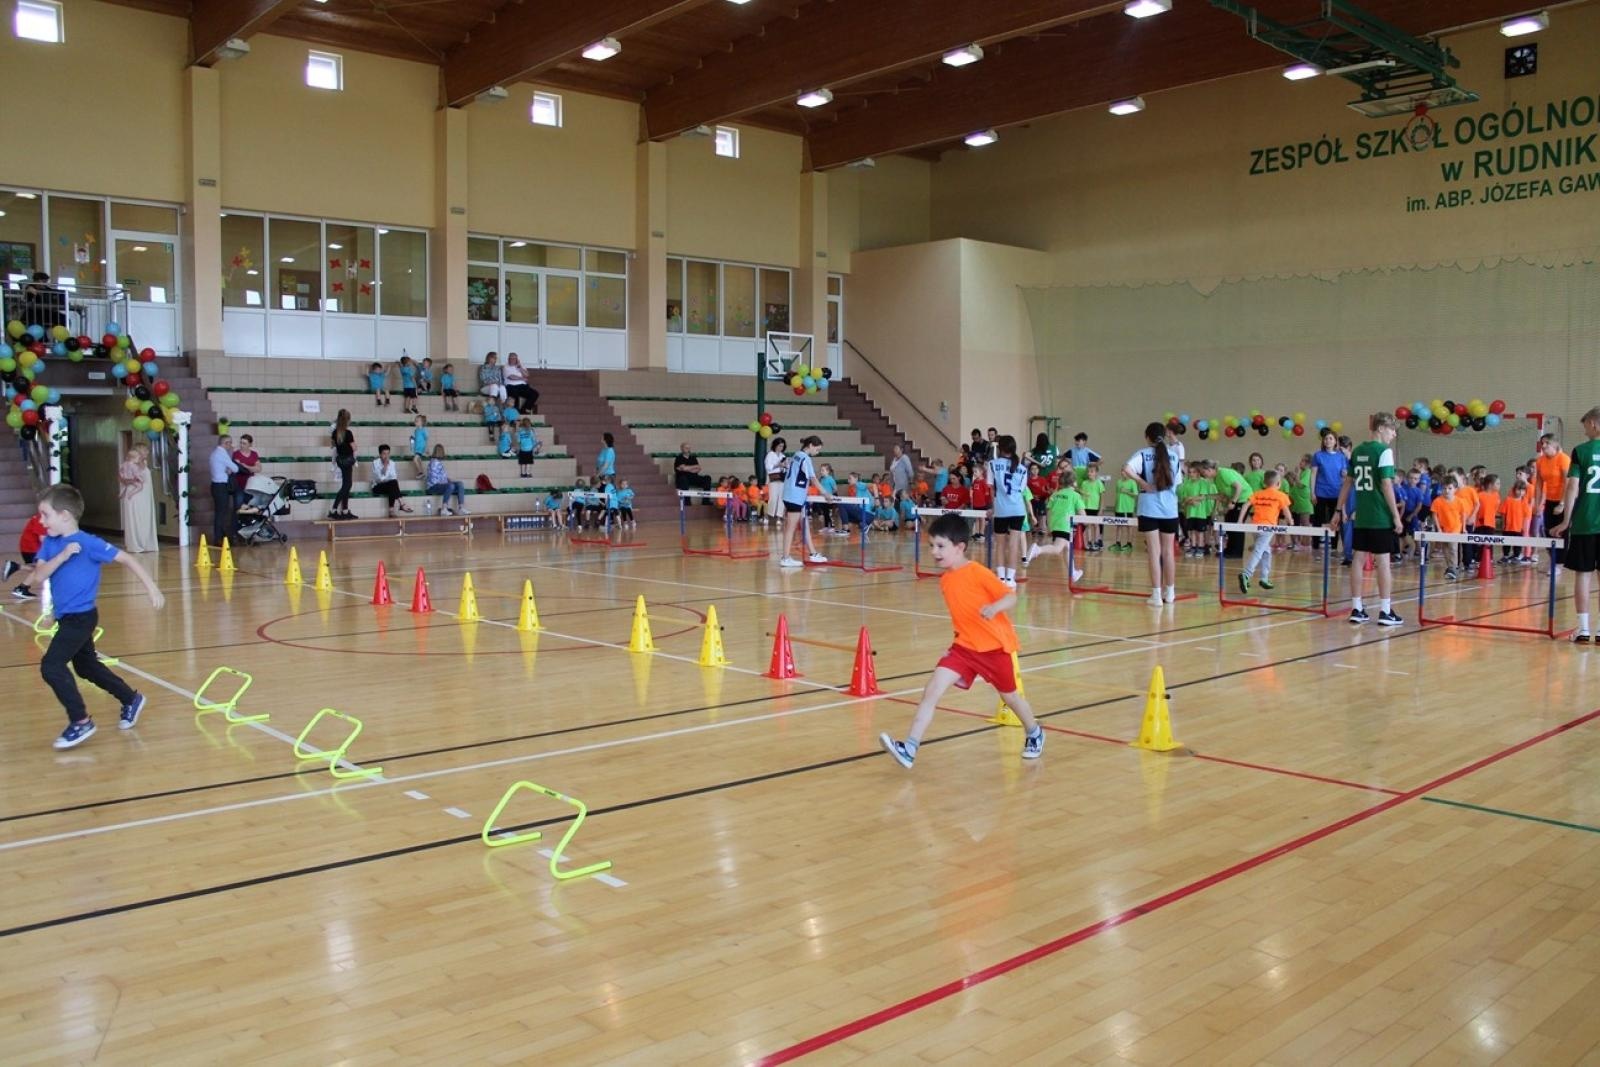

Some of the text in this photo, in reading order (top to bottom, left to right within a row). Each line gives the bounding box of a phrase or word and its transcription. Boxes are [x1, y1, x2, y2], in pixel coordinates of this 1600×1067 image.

[1249, 134, 1348, 175] ZESPÓŁ
[1454, 95, 1600, 145] OGÓLNO
[1474, 133, 1597, 178] RUDNIK
[1407, 196, 1430, 212] im.
[1435, 190, 1474, 209] ABP.
[1480, 177, 1553, 204] JÓZEFA
[1004, 473, 1012, 495] 5
[1354, 465, 1374, 491] 25
[1467, 535, 1504, 544] POLANIK
